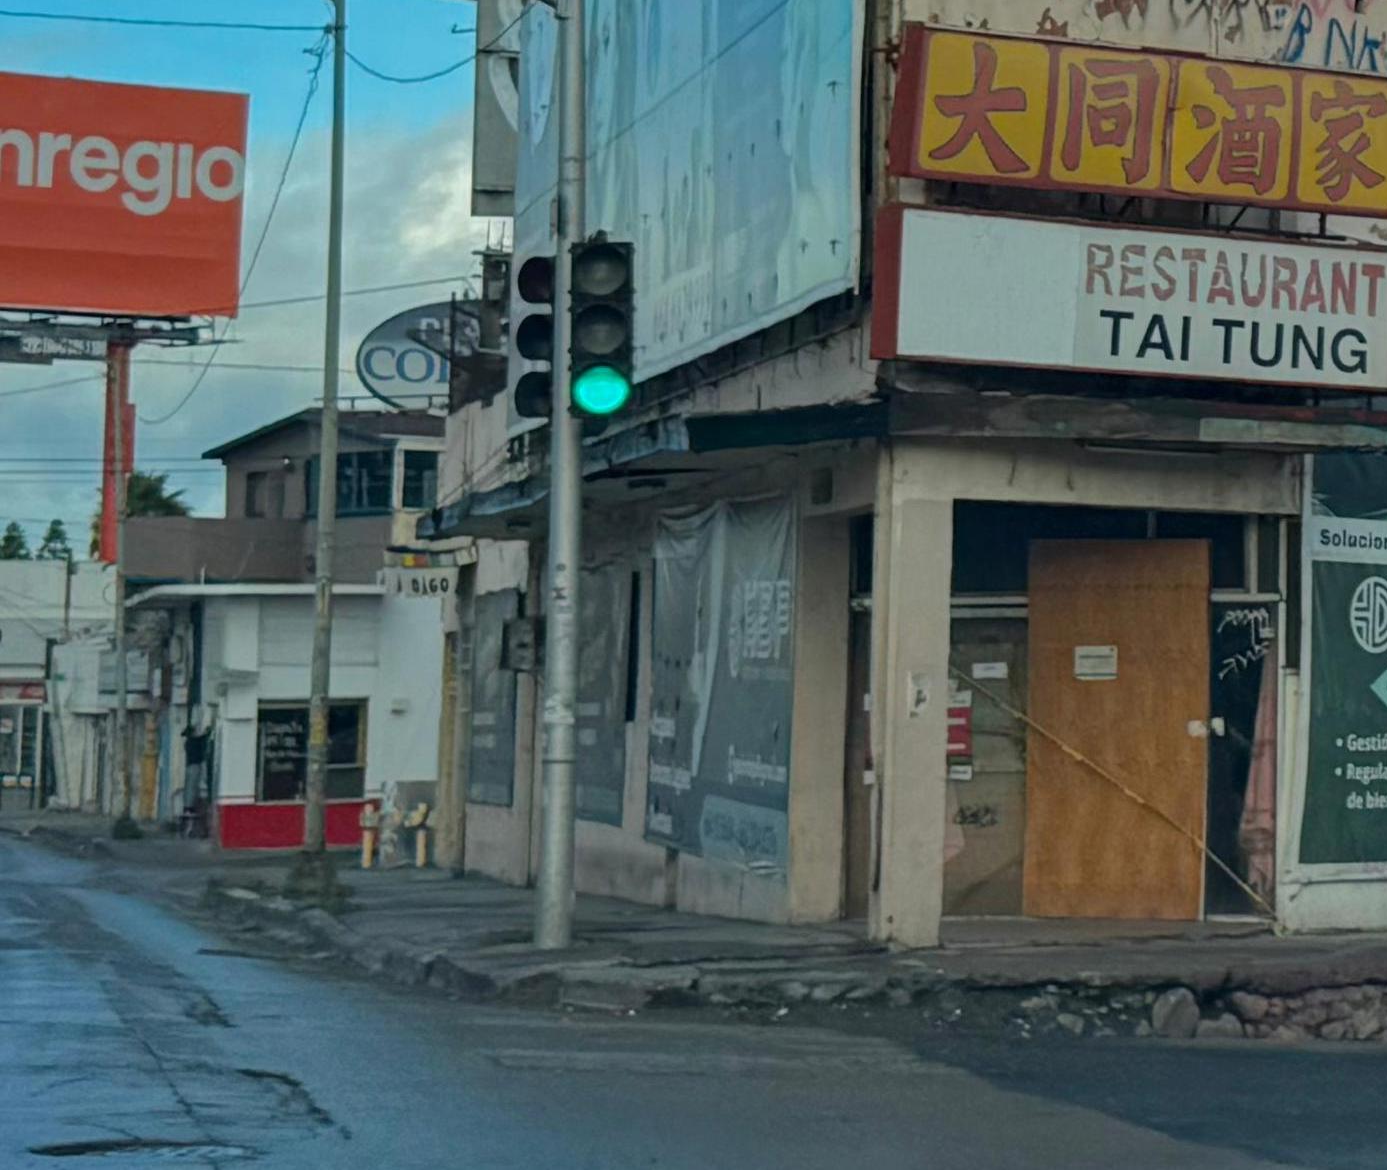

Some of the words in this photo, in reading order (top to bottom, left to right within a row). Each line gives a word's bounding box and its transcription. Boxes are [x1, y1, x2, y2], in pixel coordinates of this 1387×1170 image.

[1085, 243, 1386, 317] RESTAURANT
[1100, 309, 1192, 363] TAI
[1212, 318, 1368, 375] TUNG
[1346, 792, 1364, 810] de
